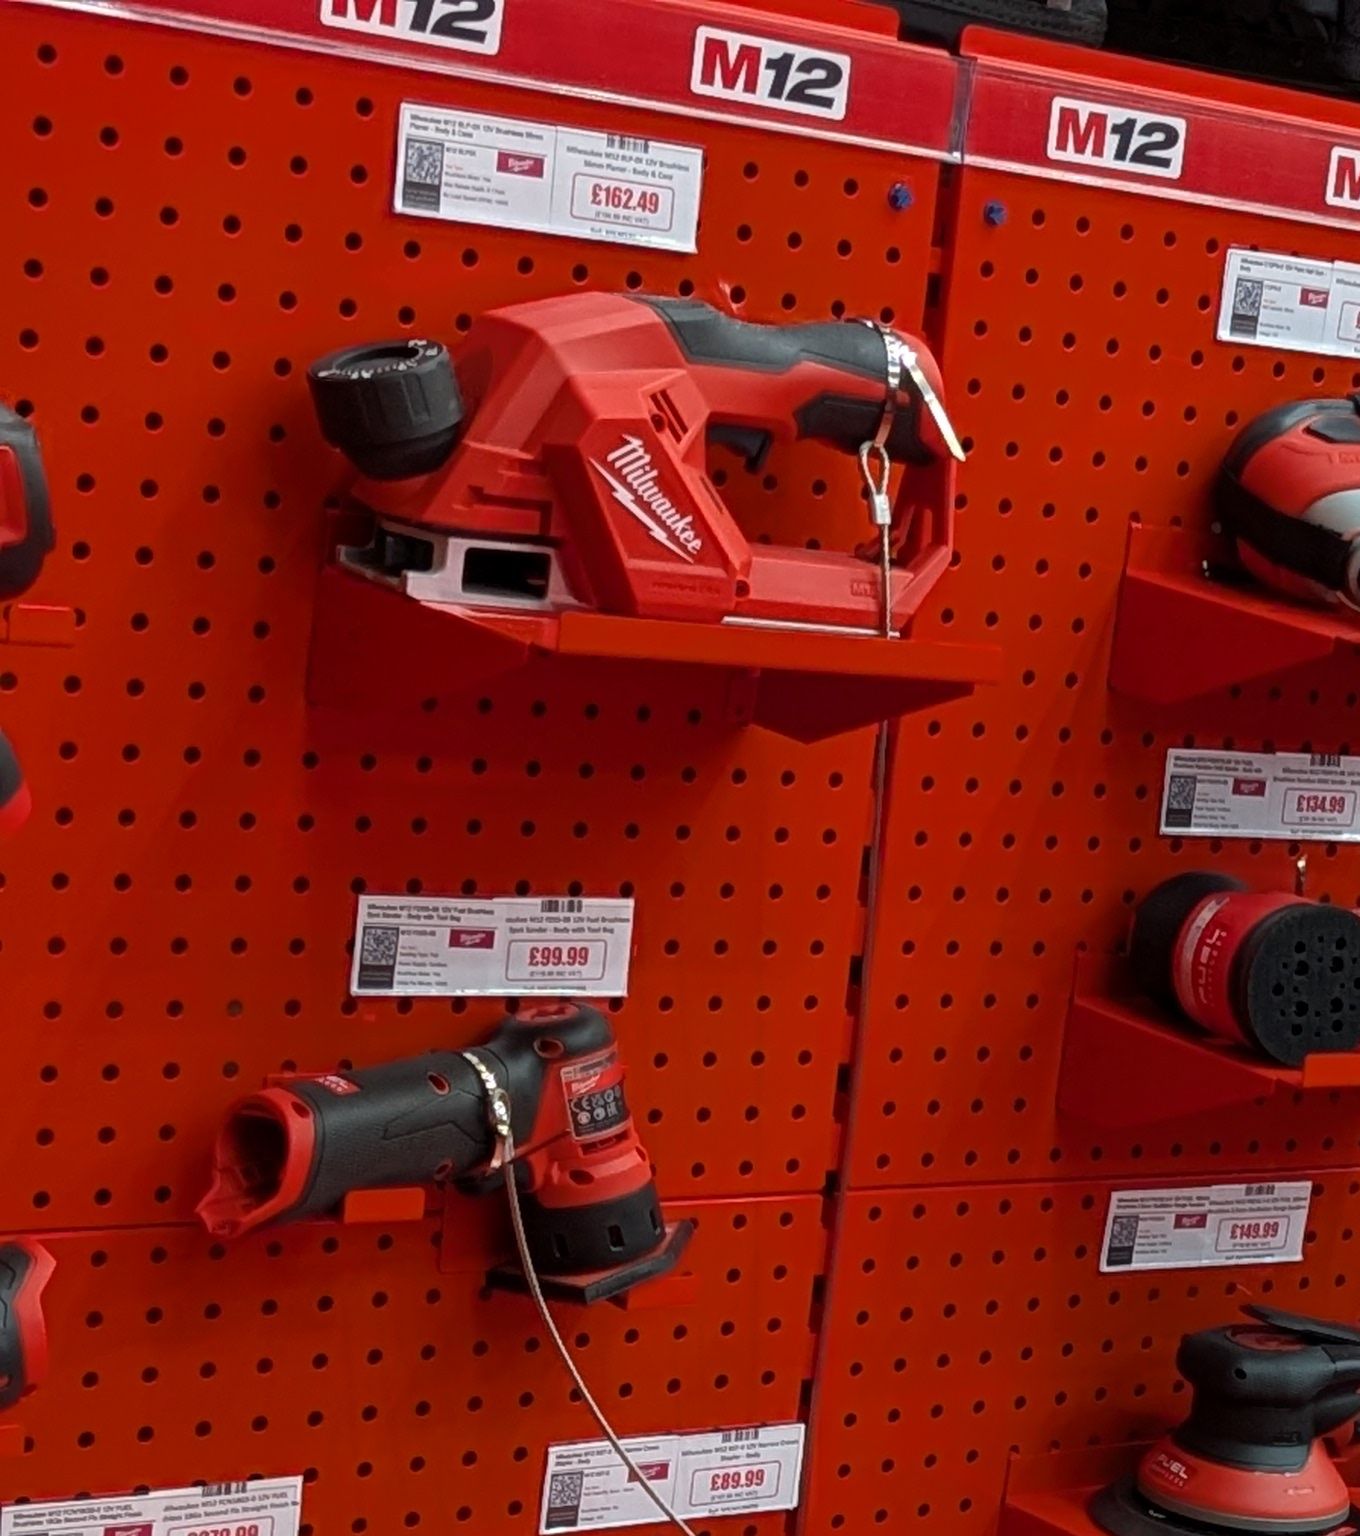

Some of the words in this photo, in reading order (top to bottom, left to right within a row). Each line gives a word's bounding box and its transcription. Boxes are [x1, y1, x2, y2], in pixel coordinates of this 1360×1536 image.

[701, 38, 843, 108] M12
[1057, 109, 1179, 171] M12
[591, 183, 659, 214] £162.49
[606, 433, 702, 555] Milwaukee
[1296, 795, 1345, 814] £134.99
[528, 946, 589, 967] £99.99
[710, 1469, 765, 1491] £89.99
